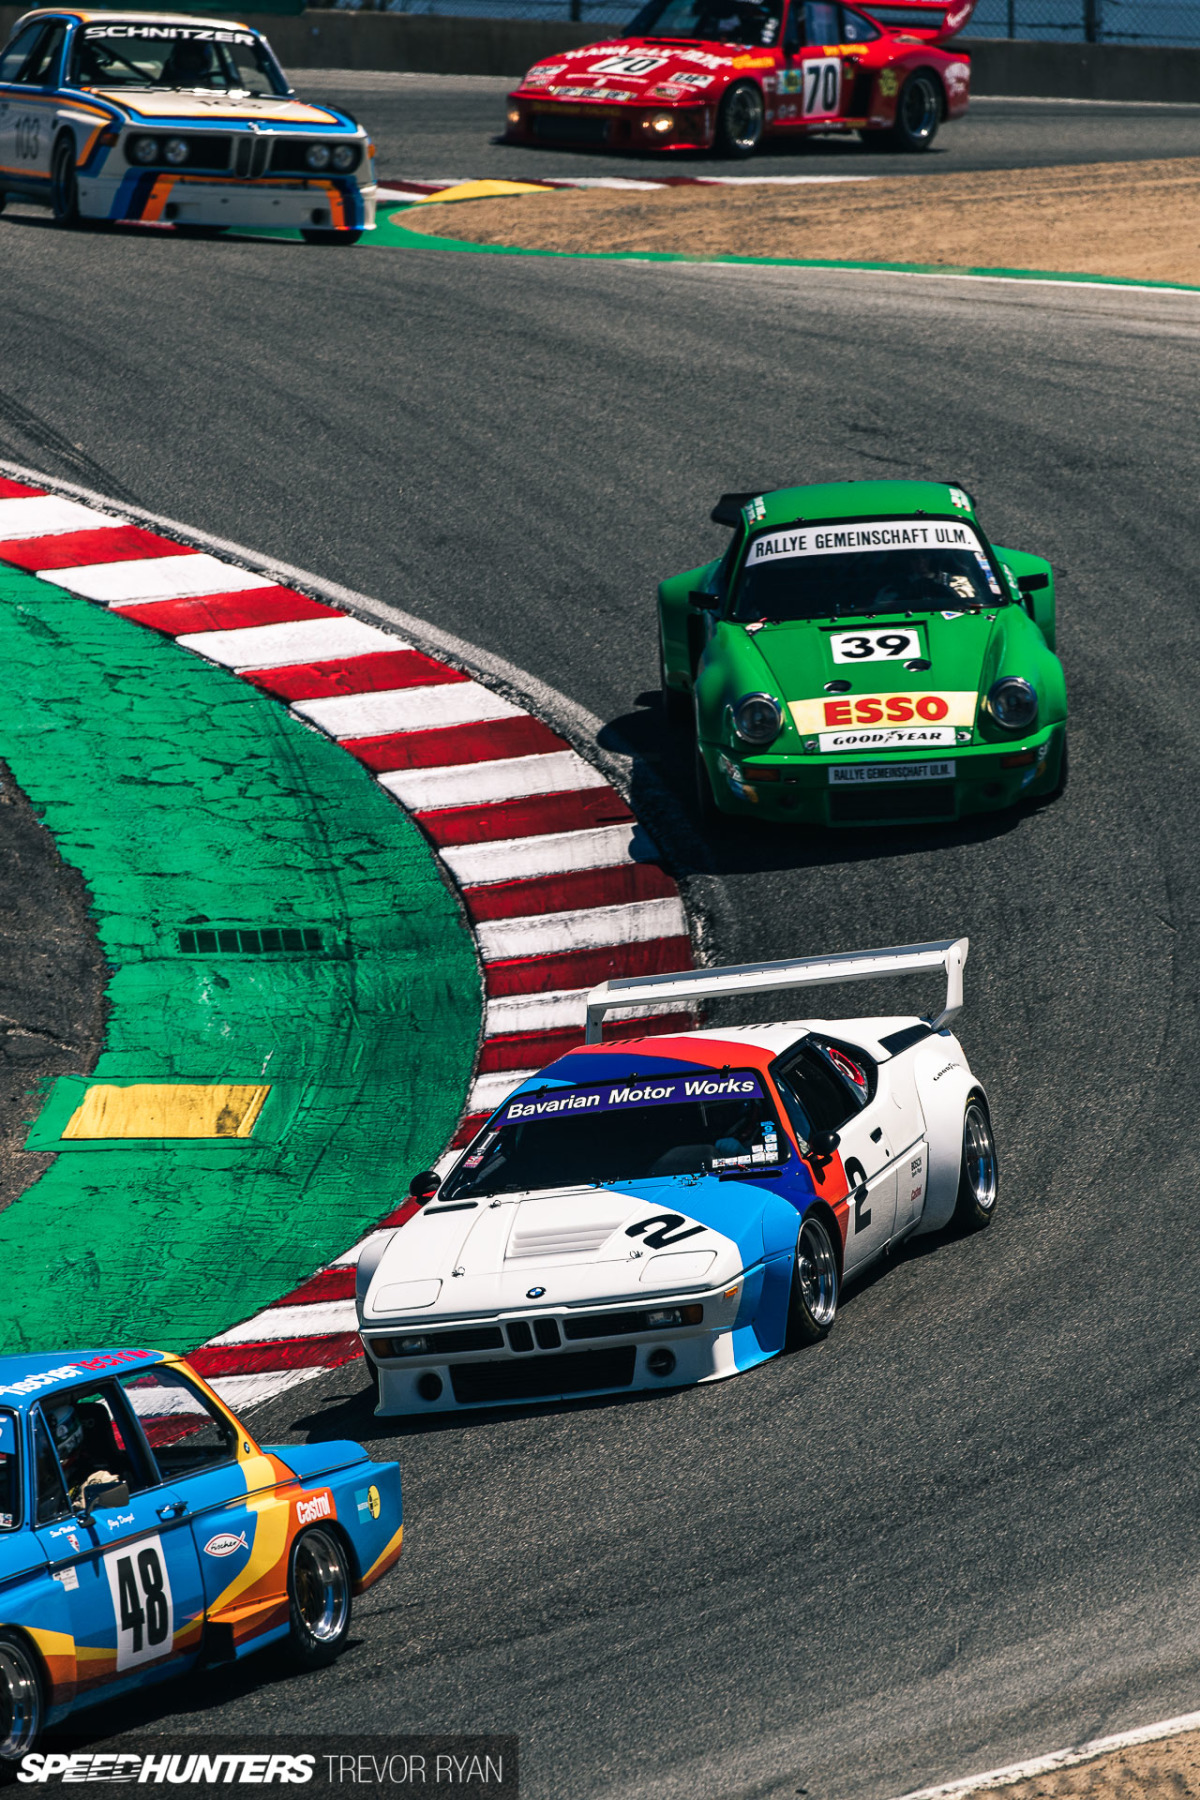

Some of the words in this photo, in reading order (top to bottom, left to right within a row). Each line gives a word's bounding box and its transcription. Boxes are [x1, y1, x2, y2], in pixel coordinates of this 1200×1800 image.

[84, 26, 256, 46] SCHNITZER
[597, 56, 654, 73] 70
[806, 64, 837, 114] 70
[14, 117, 40, 160] 103
[756, 535, 807, 557] RALLYE
[815, 528, 929, 549] GEMEINSCHAFT
[936, 528, 972, 546] ULM.
[840, 634, 911, 658] 39
[823, 695, 949, 727] ESSO
[832, 730, 942, 745] GOODYEAR
[834, 768, 865, 780] RALLYE
[866, 766, 928, 779] GEMEINSCHAFT
[506, 1093, 600, 1120] Bavarian
[608, 1085, 676, 1105] Motor
[684, 1078, 755, 1097] Works
[844, 1156, 872, 1236] 2
[625, 1214, 708, 1250] 2
[296, 1492, 331, 1524] Castrol
[116, 1547, 171, 1653] 48
